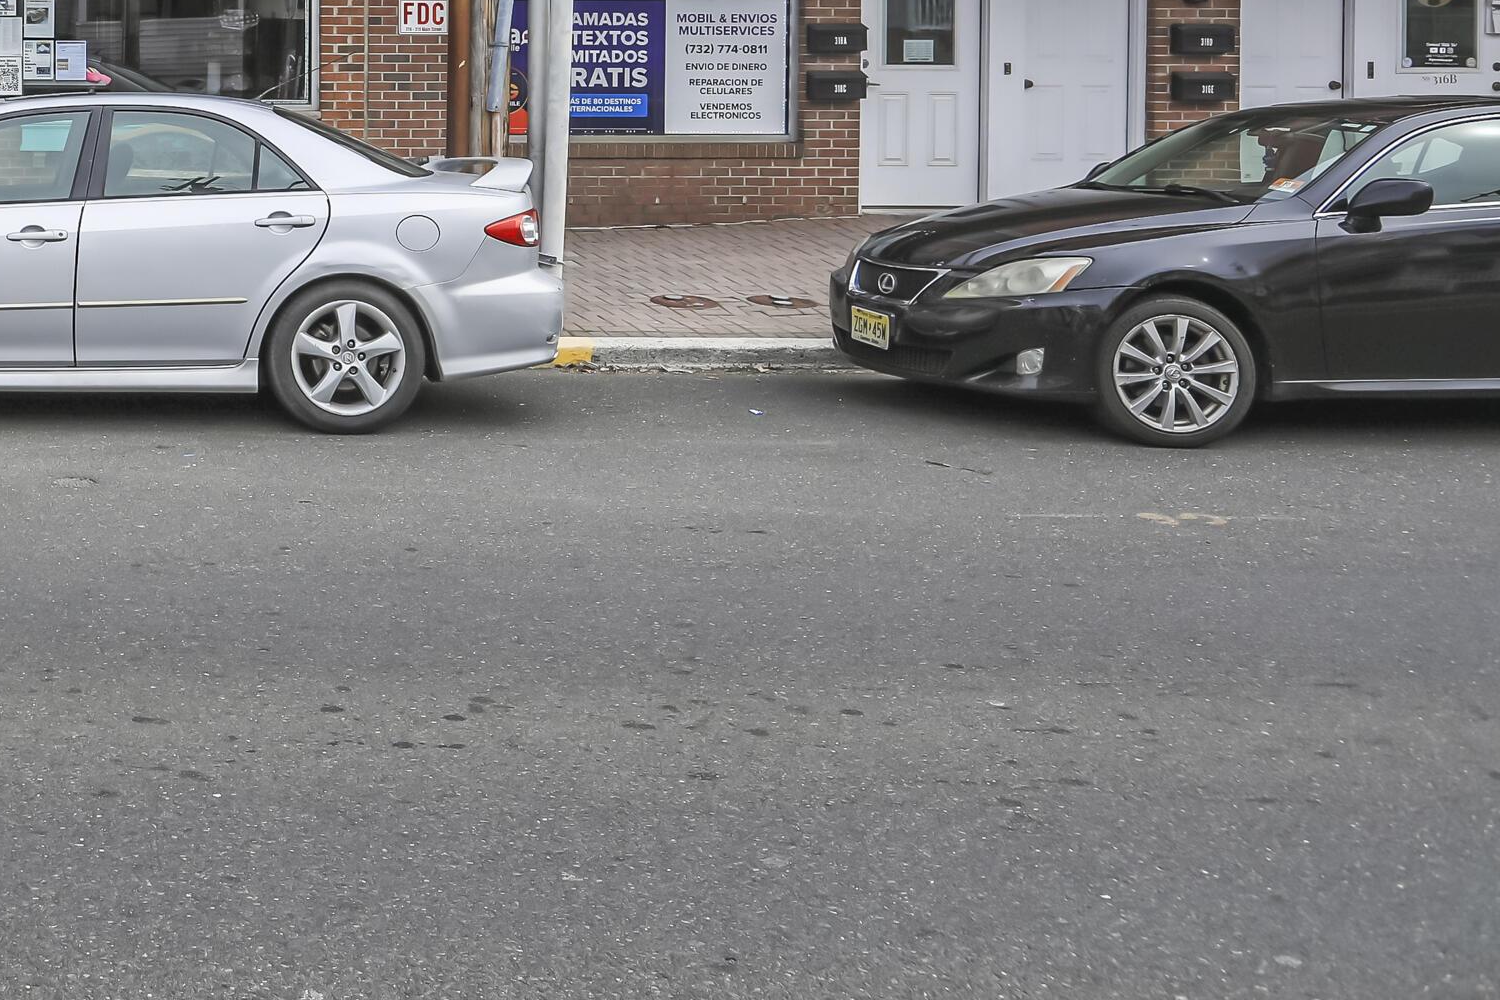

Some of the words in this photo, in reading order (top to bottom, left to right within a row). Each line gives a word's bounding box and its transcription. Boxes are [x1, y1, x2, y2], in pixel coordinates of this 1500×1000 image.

[403, 2, 445, 26] FDC
[572, 12, 649, 26] AMADAS
[676, 13, 716, 23] MOBIL
[719, 14, 727, 23] &
[730, 14, 778, 23] ENVIOS
[678, 26, 775, 36] MULTISERVICES
[572, 30, 649, 46] TEXTOS
[685, 44, 714, 54] (732)
[717, 44, 768, 54] 774-0811
[571, 50, 648, 63] MITADOS
[685, 63, 714, 71] ENVIO
[717, 63, 729, 71] DE
[732, 63, 767, 71] DINERO
[571, 67, 648, 88] RATIS
[689, 79, 748, 87] REPARACION
[751, 79, 763, 87] DE
[570, 96, 580, 105] ÁS
